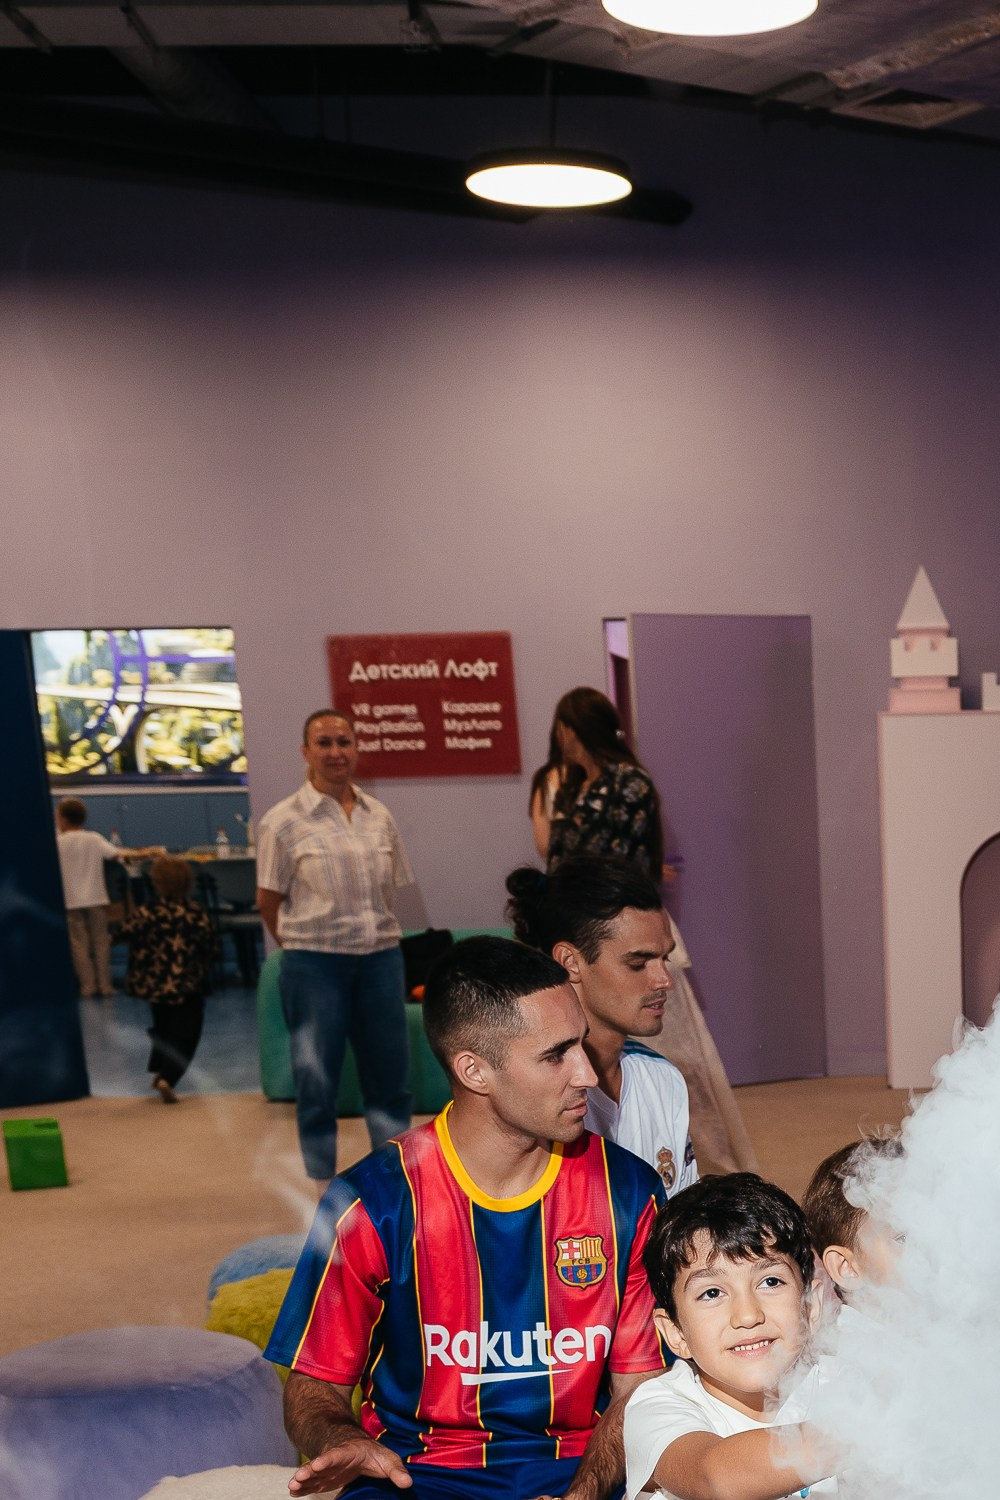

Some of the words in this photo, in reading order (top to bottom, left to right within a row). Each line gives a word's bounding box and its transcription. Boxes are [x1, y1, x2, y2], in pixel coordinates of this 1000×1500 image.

[349, 659, 439, 682] Детский
[444, 658, 498, 681] Лофт
[352, 703, 370, 716] VR
[372, 705, 417, 718] games
[442, 701, 501, 715] Караоке
[354, 721, 424, 734] PlayStation
[382, 738, 426, 751] Dance
[445, 736, 492, 750] Мафия
[571, 1257, 591, 1265] FCB
[424, 1321, 612, 1367] Rakuten
